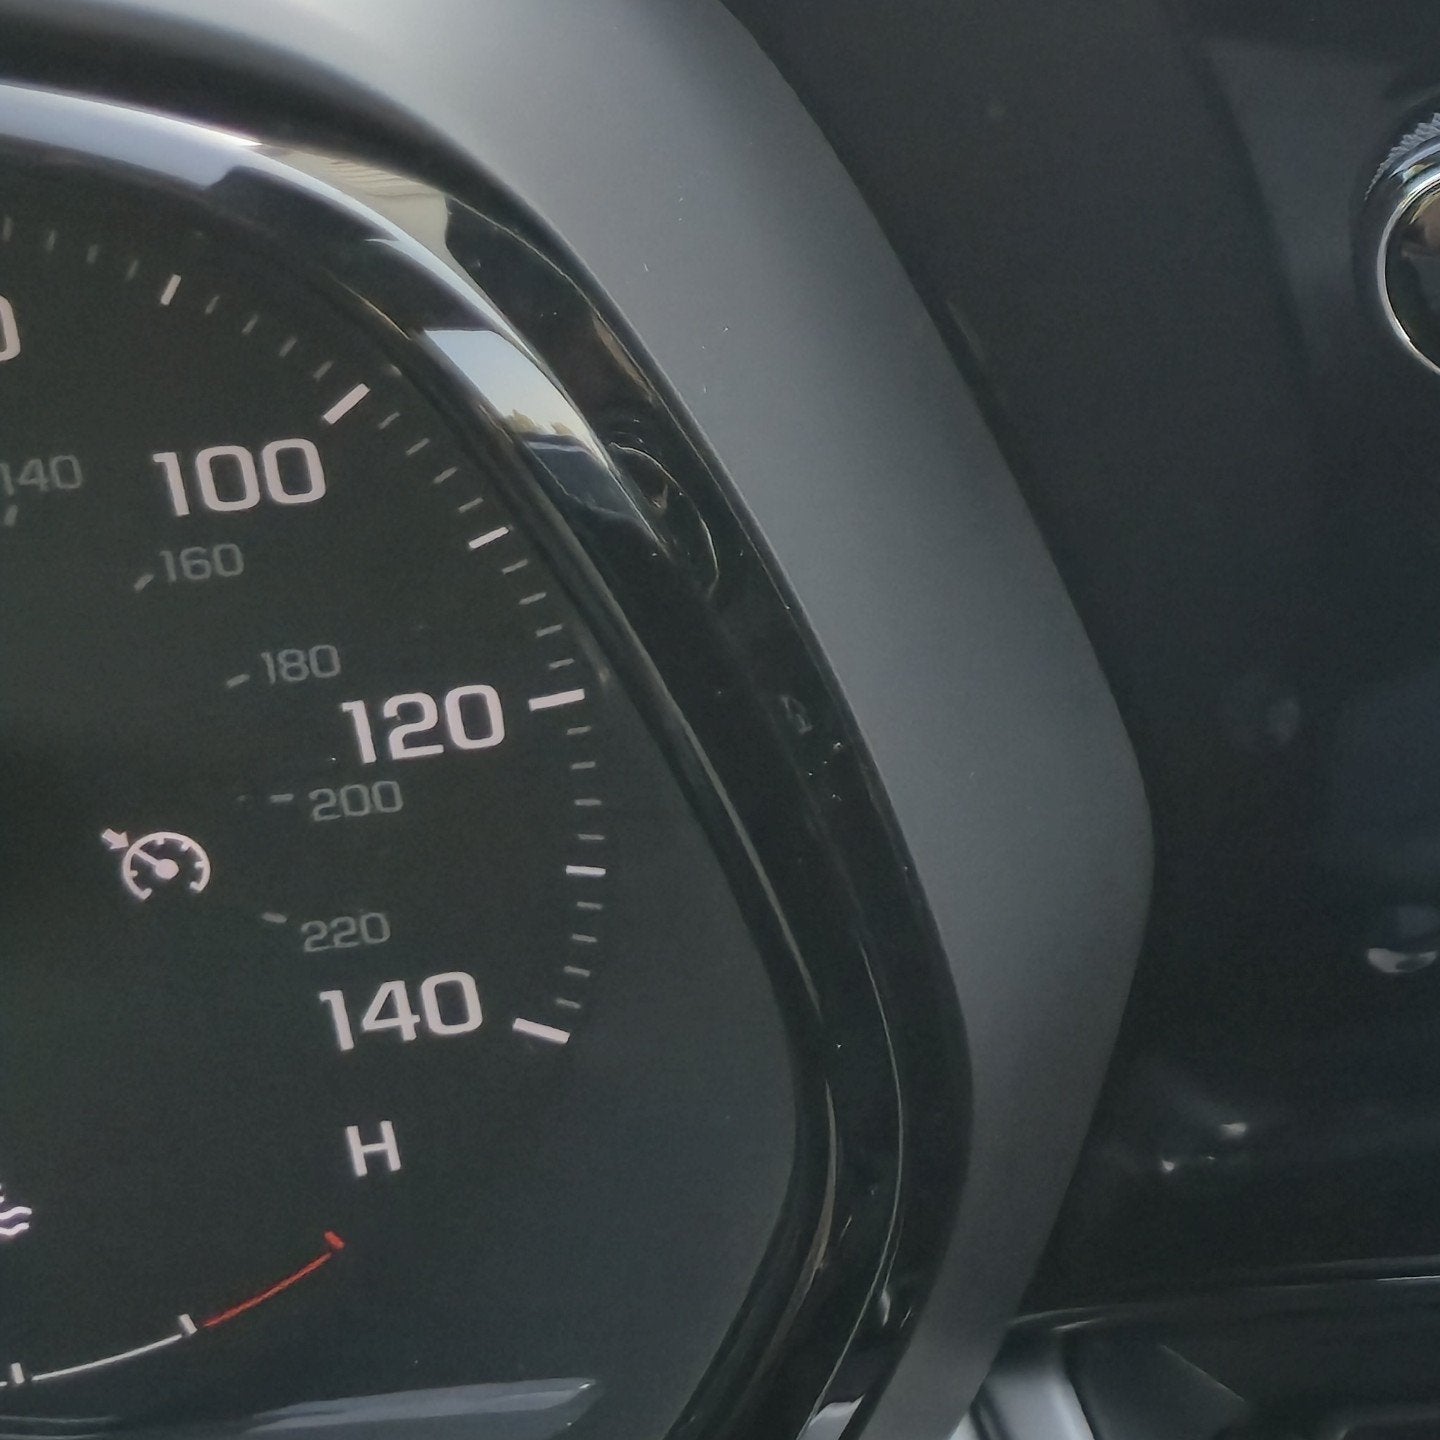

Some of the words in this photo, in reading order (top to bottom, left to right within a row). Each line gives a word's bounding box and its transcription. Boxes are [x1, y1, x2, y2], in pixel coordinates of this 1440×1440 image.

[151, 436, 328, 518] 100
[158, 542, 246, 584] 160
[259, 643, 343, 686] 180
[339, 683, 506, 765] 120
[307, 779, 405, 823] 200
[298, 910, 392, 954] 220
[317, 970, 485, 1053] 140
[344, 1119, 403, 1178] H
